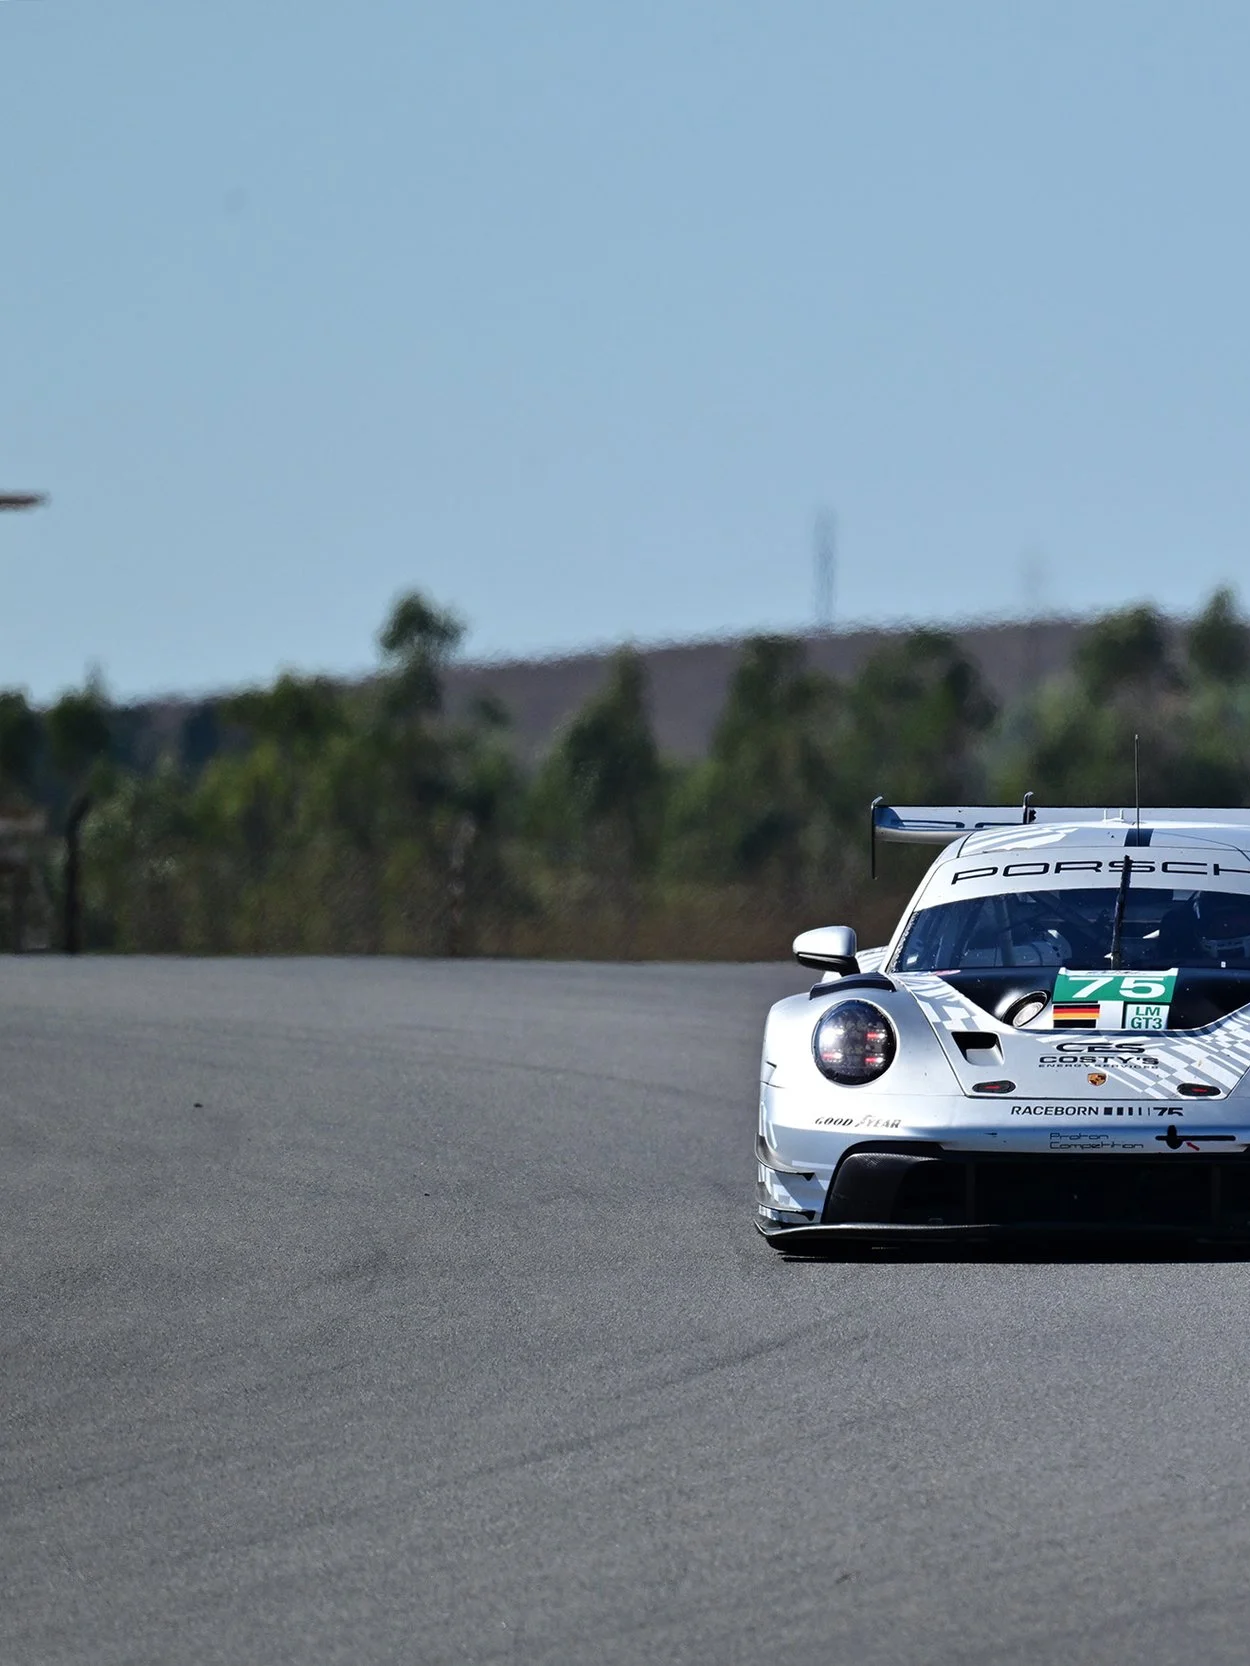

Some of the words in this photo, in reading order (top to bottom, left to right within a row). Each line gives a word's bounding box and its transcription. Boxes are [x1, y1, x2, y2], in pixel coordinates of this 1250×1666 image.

[1068, 976, 1166, 999] 75
[1135, 1006, 1161, 1016] LM
[1130, 1016, 1163, 1029] GT3
[1056, 1042, 1146, 1053] CES
[1039, 1055, 1159, 1065] COSTY'S
[1010, 1105, 1099, 1116] RACEBORN
[1153, 1106, 1184, 1116] 75
[1049, 1132, 1109, 1140] Proton
[1049, 1141, 1144, 1149] Competition
